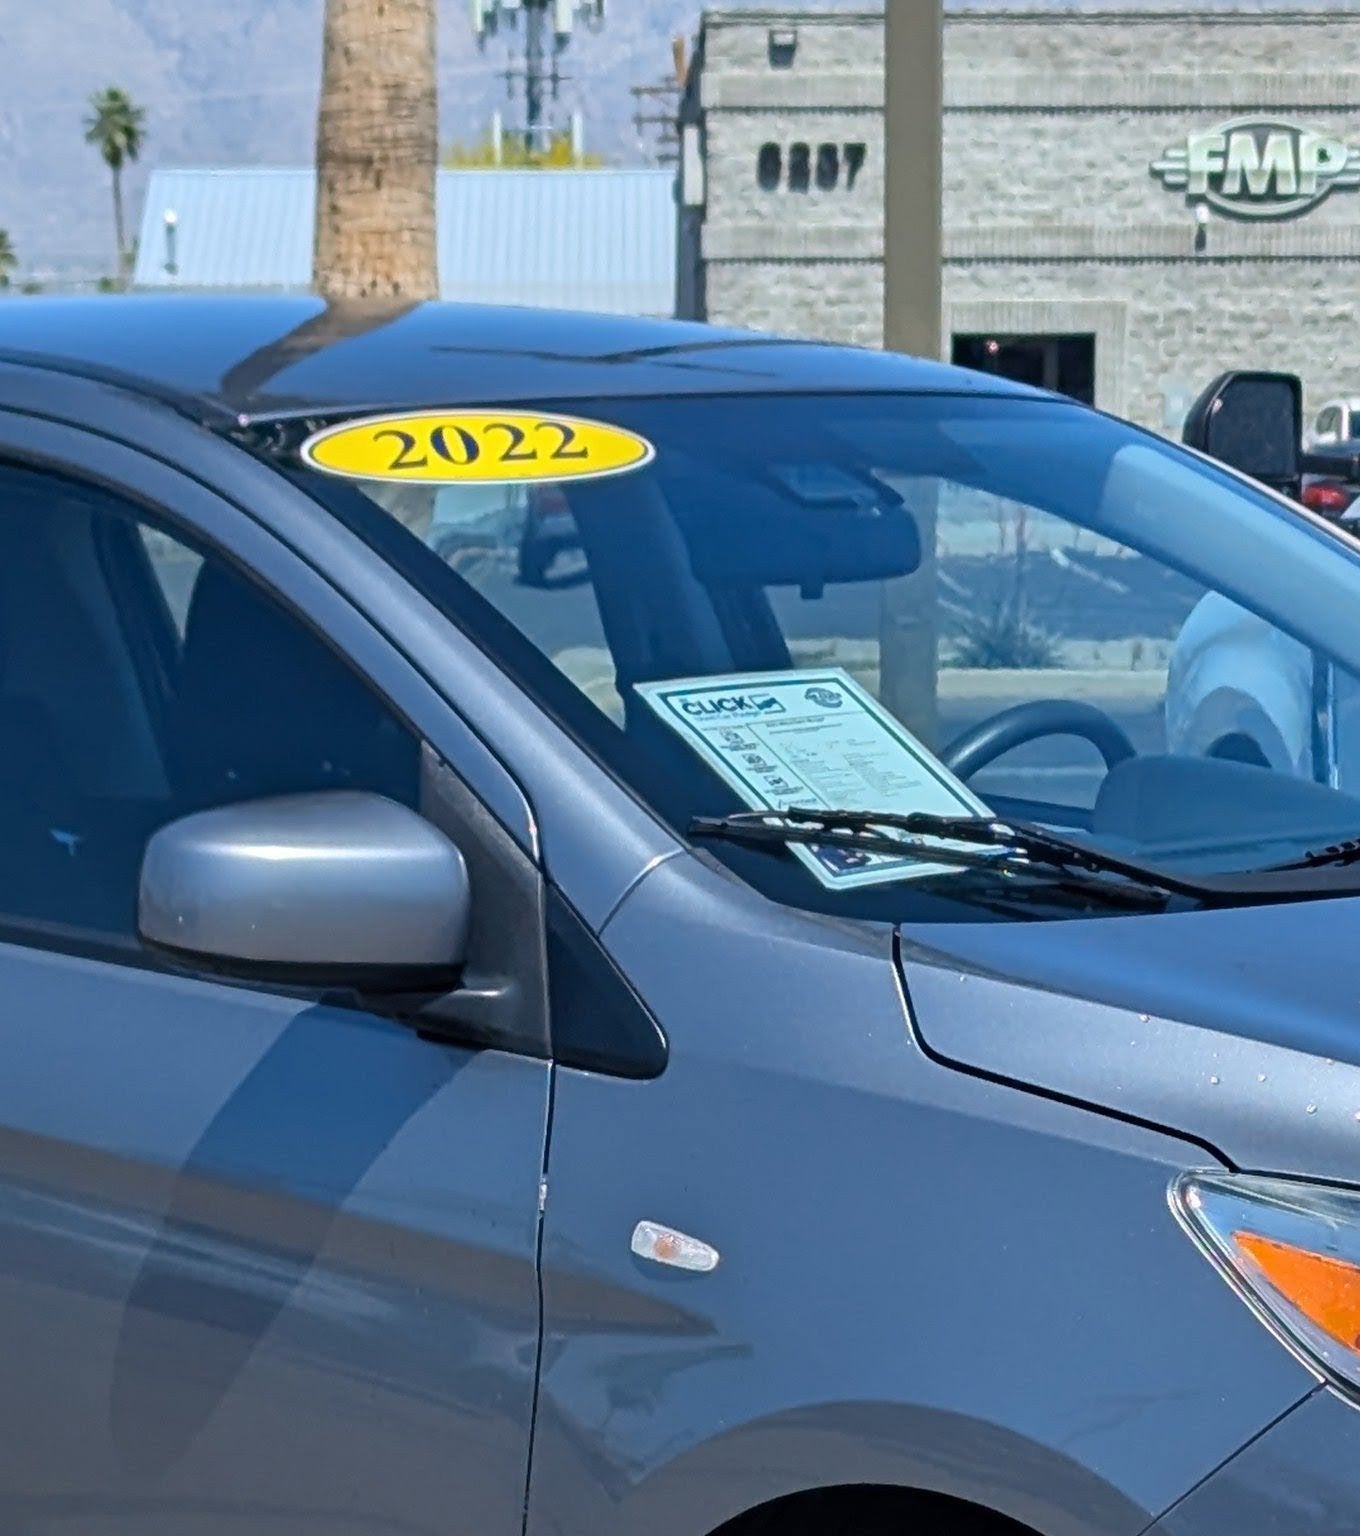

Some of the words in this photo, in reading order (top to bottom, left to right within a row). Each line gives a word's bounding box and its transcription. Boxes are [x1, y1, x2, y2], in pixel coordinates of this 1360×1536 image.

[1186, 132, 1349, 200] FMP
[372, 421, 589, 471] 2022
[681, 694, 754, 717] CLICK
